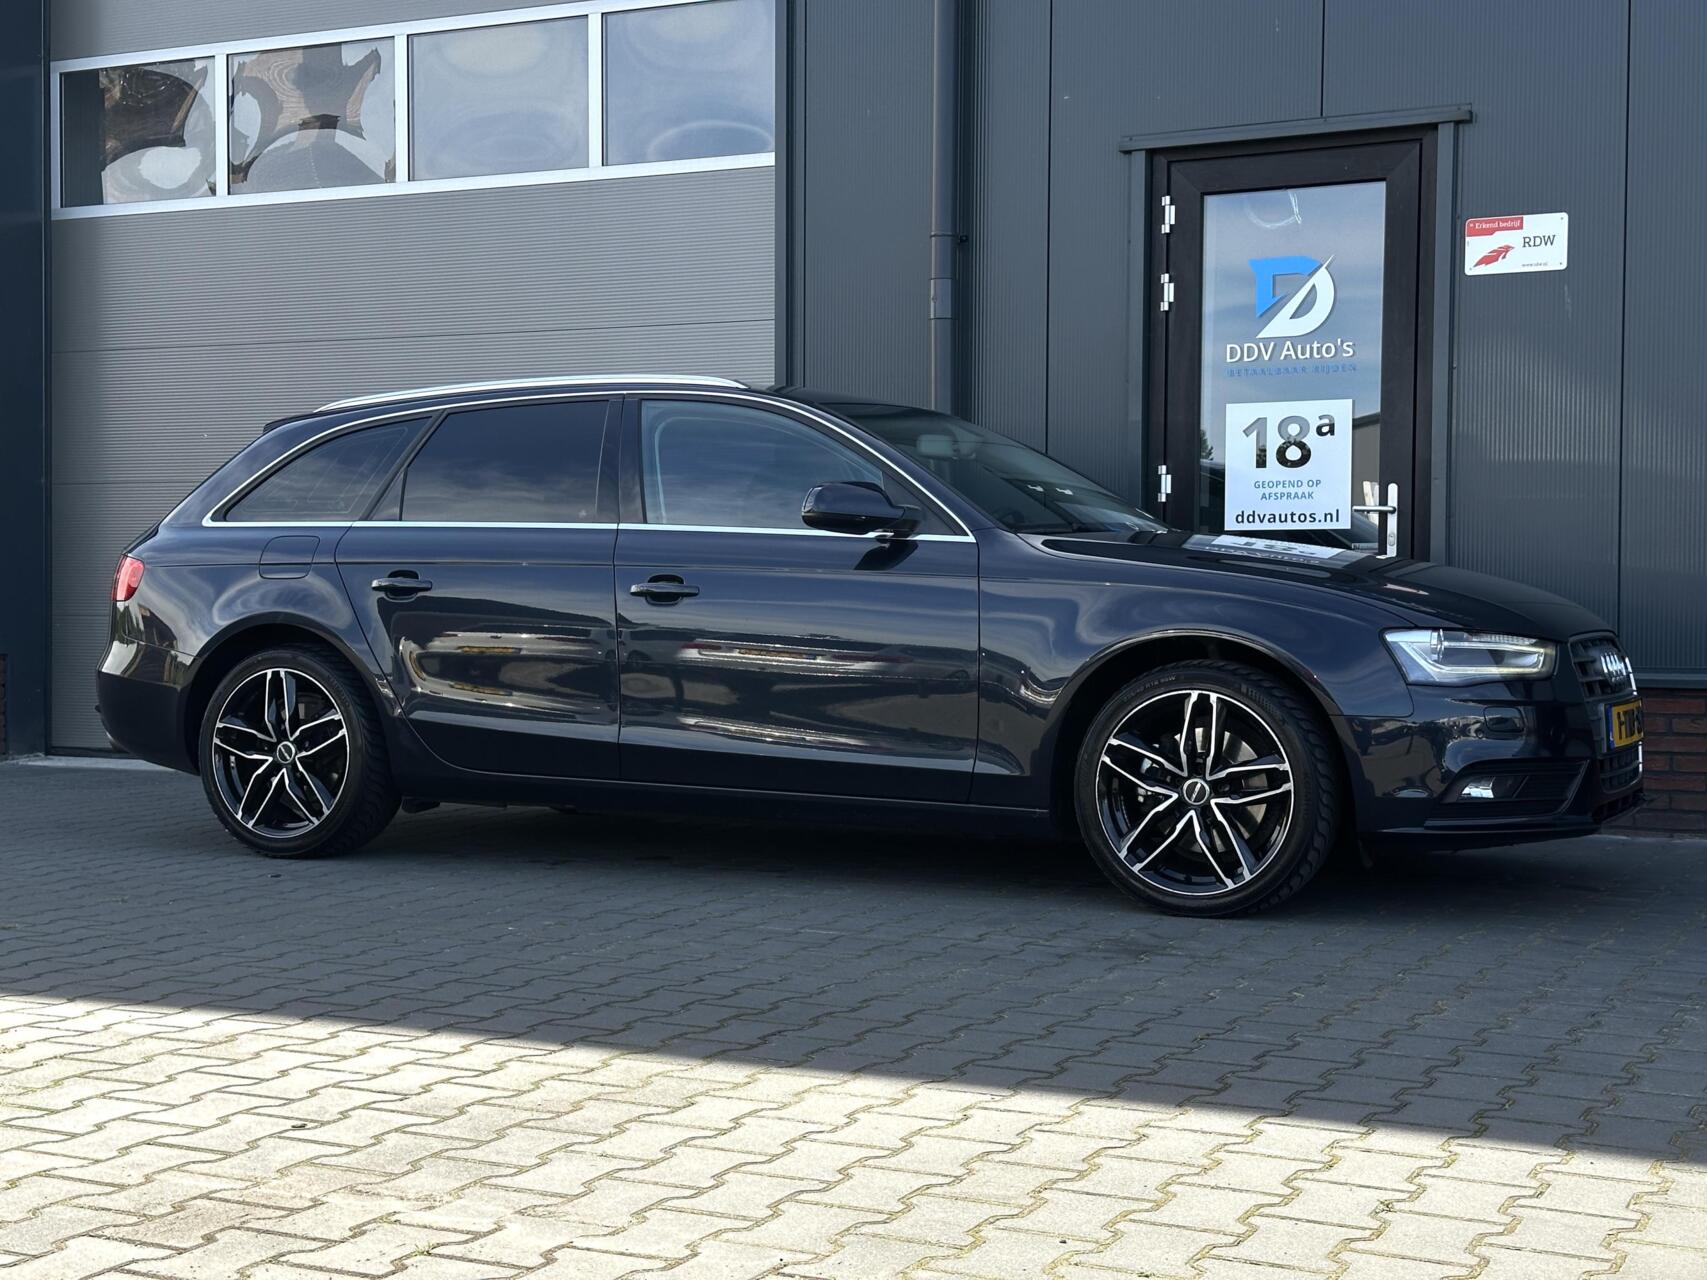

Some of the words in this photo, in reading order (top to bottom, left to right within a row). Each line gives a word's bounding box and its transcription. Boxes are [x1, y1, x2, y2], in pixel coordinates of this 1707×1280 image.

[1499, 220, 1520, 228] bedrijf
[1522, 234, 1556, 248] RDW
[1226, 341, 1275, 362] DDV
[1280, 338, 1354, 360] Auto's
[1254, 480, 1303, 489] GEOPEND
[1307, 479, 1322, 488] OP
[1260, 491, 1314, 500] AFSPRAAK
[1235, 508, 1340, 524] ddvautos.nl
